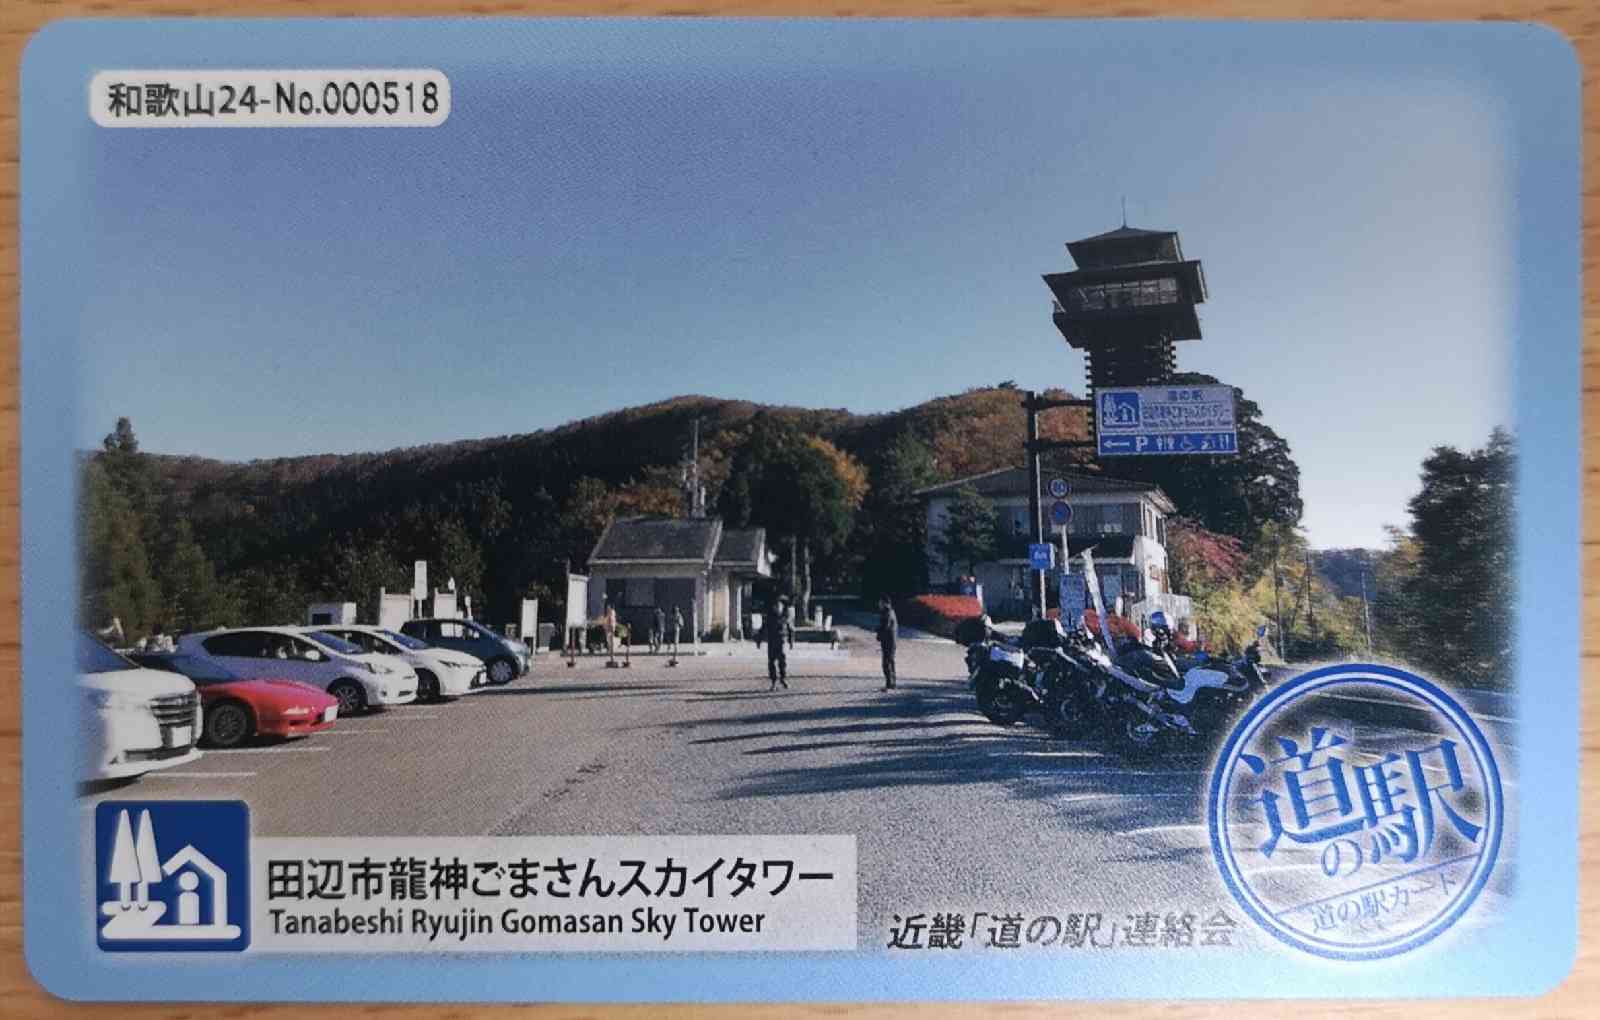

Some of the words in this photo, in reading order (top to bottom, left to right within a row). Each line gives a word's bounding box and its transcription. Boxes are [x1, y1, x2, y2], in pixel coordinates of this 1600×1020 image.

[108, 82, 439, 118] 和歌山24-No.000518
[267, 858, 835, 900] 田辺市龍神ごまさんスカイタワー
[269, 908, 403, 934] Tanabeshi
[411, 907, 493, 941] Ryujin
[501, 908, 623, 934] Gomasan
[631, 907, 676, 941] Sky
[684, 907, 766, 933] Tower
[887, 911, 1238, 951] 近畿「道の駅」連絡会
